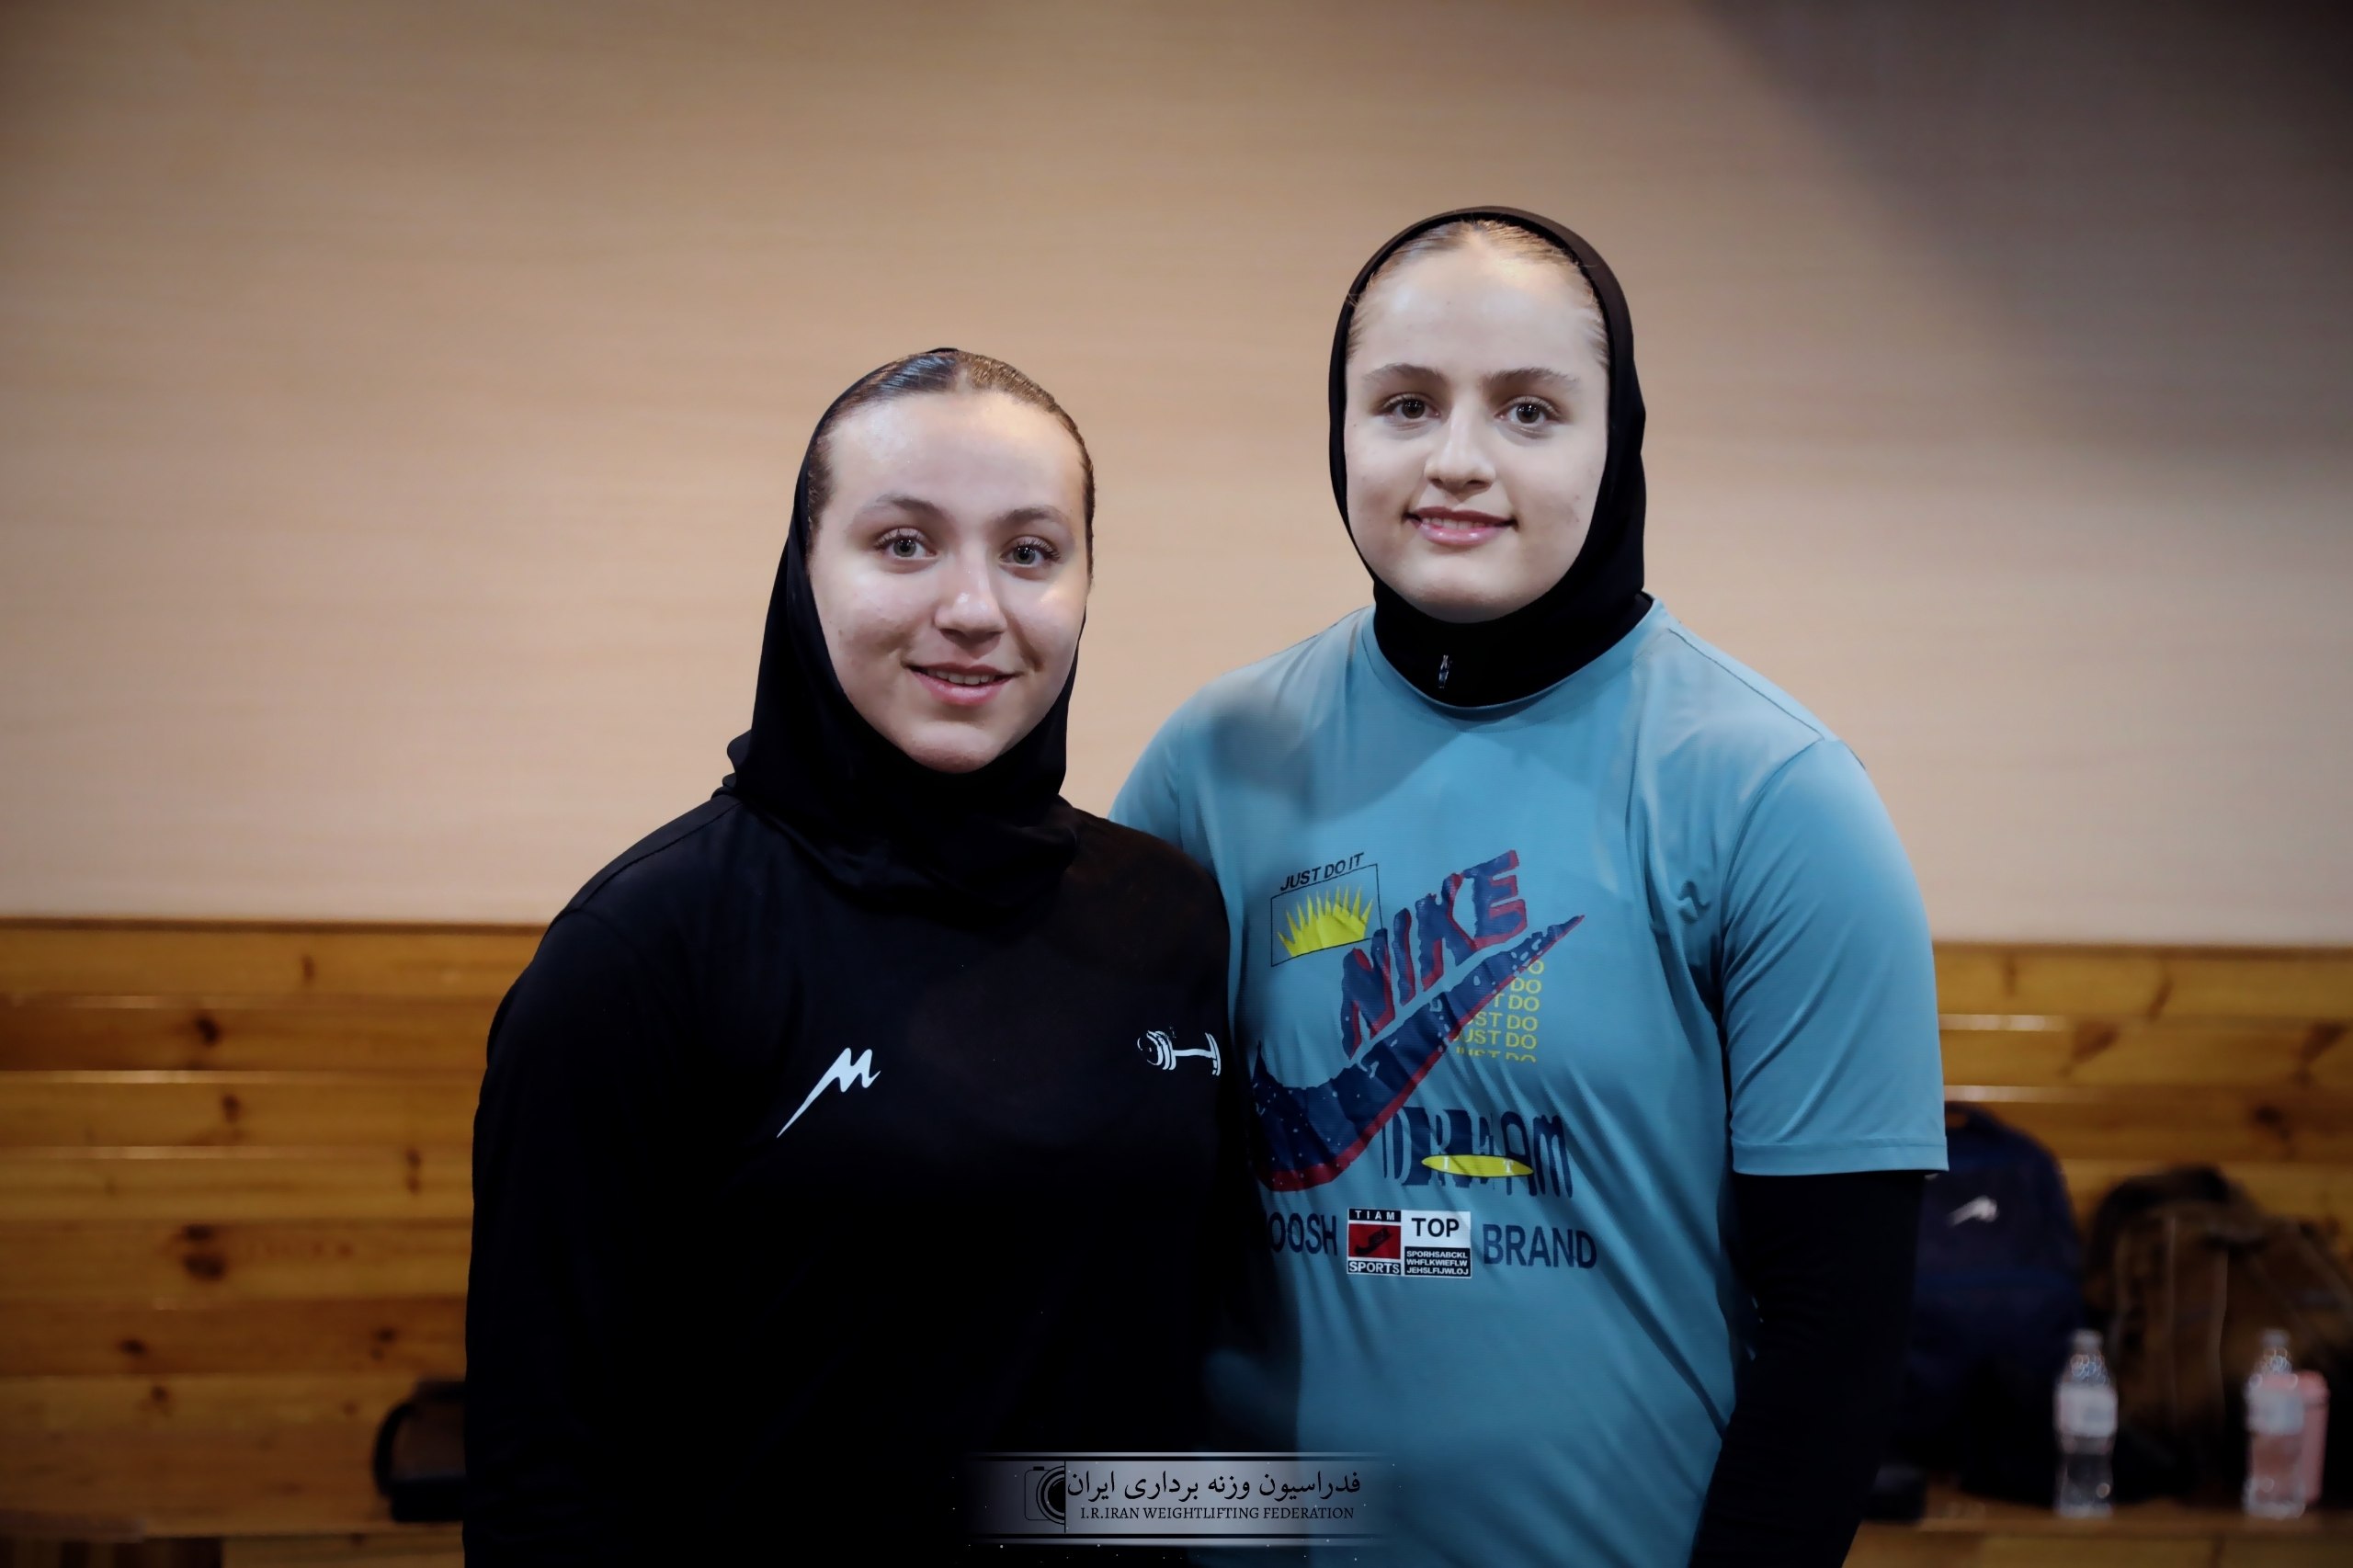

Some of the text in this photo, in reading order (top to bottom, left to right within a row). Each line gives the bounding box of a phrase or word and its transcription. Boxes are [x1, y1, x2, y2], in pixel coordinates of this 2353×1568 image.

[1279, 852, 1365, 892] JUST DO IT
[1341, 849, 1528, 1061] NIKE
[1509, 976, 1542, 994] DO
[1507, 994, 1540, 1012] DO
[1506, 1014, 1539, 1031] DO
[1506, 1031, 1537, 1050] DO
[1355, 1210, 1395, 1221] TIAM
[1265, 1211, 1338, 1256] OOSH
[1411, 1218, 1460, 1238] TOP
[1483, 1224, 1597, 1268] BRAND
[1348, 1261, 1400, 1275] SPORTS
